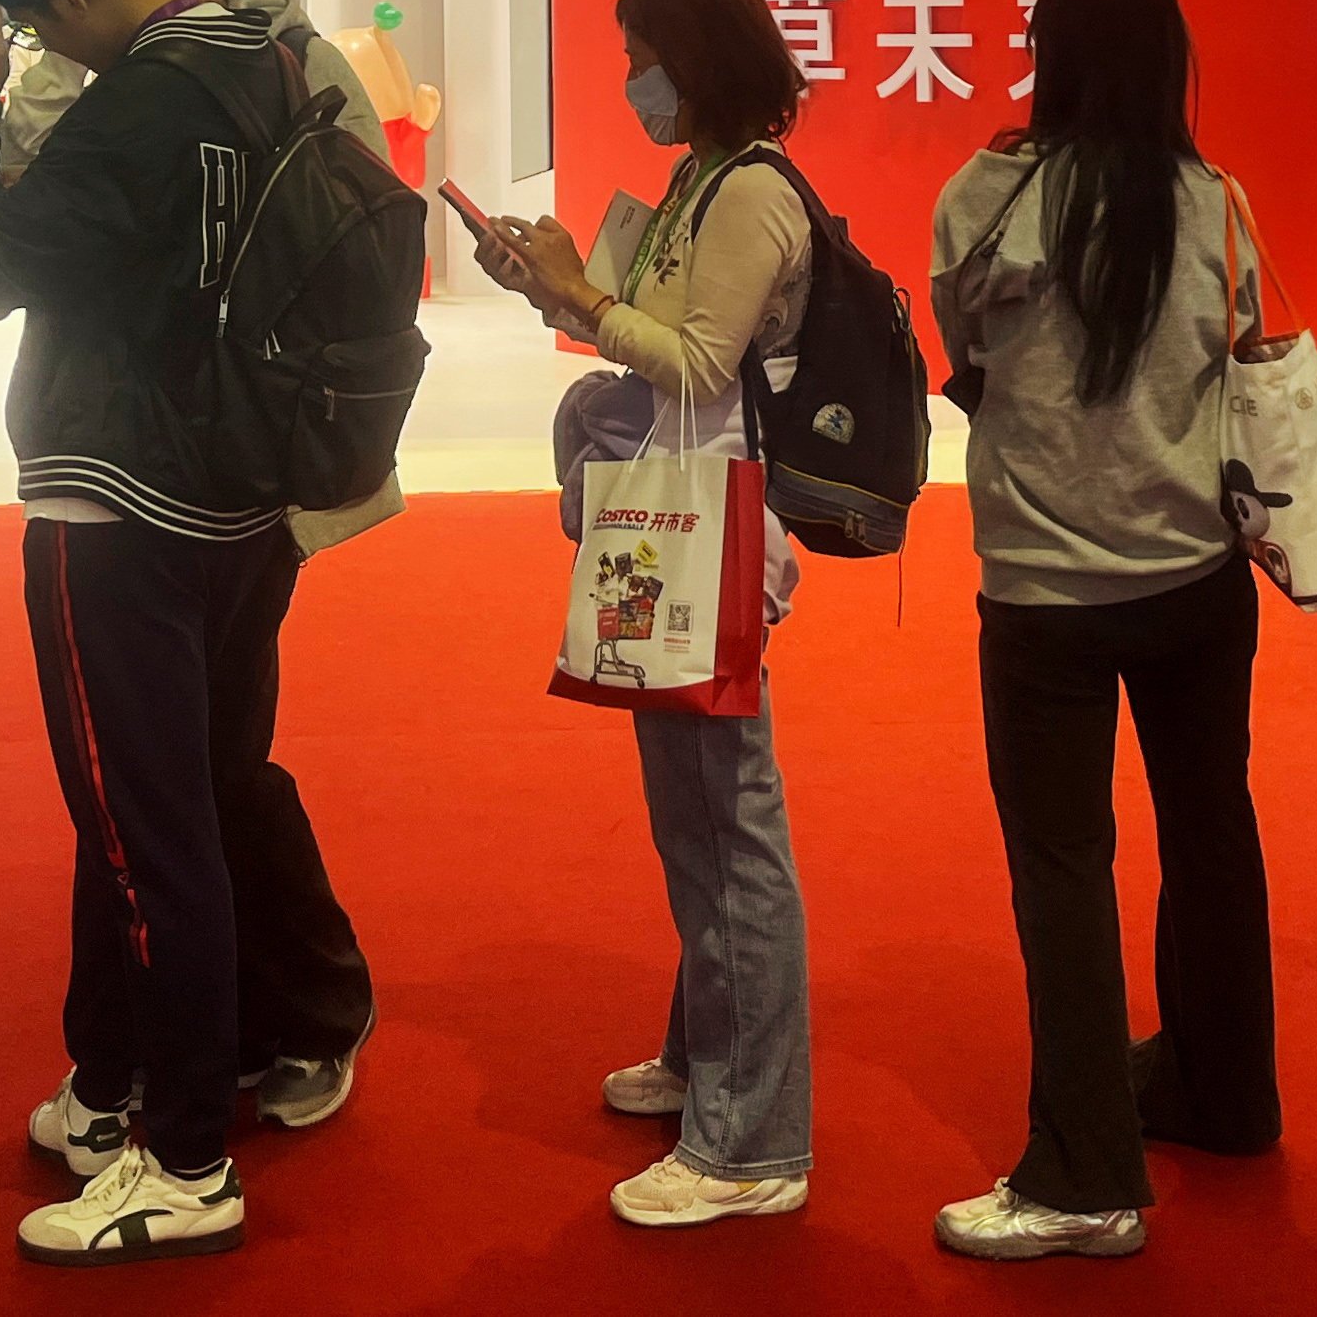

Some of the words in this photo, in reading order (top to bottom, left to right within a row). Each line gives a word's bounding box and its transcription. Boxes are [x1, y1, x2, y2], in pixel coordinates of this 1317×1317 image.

[595, 507, 649, 524] COSTCO
[648, 511, 700, 533] 开市客
